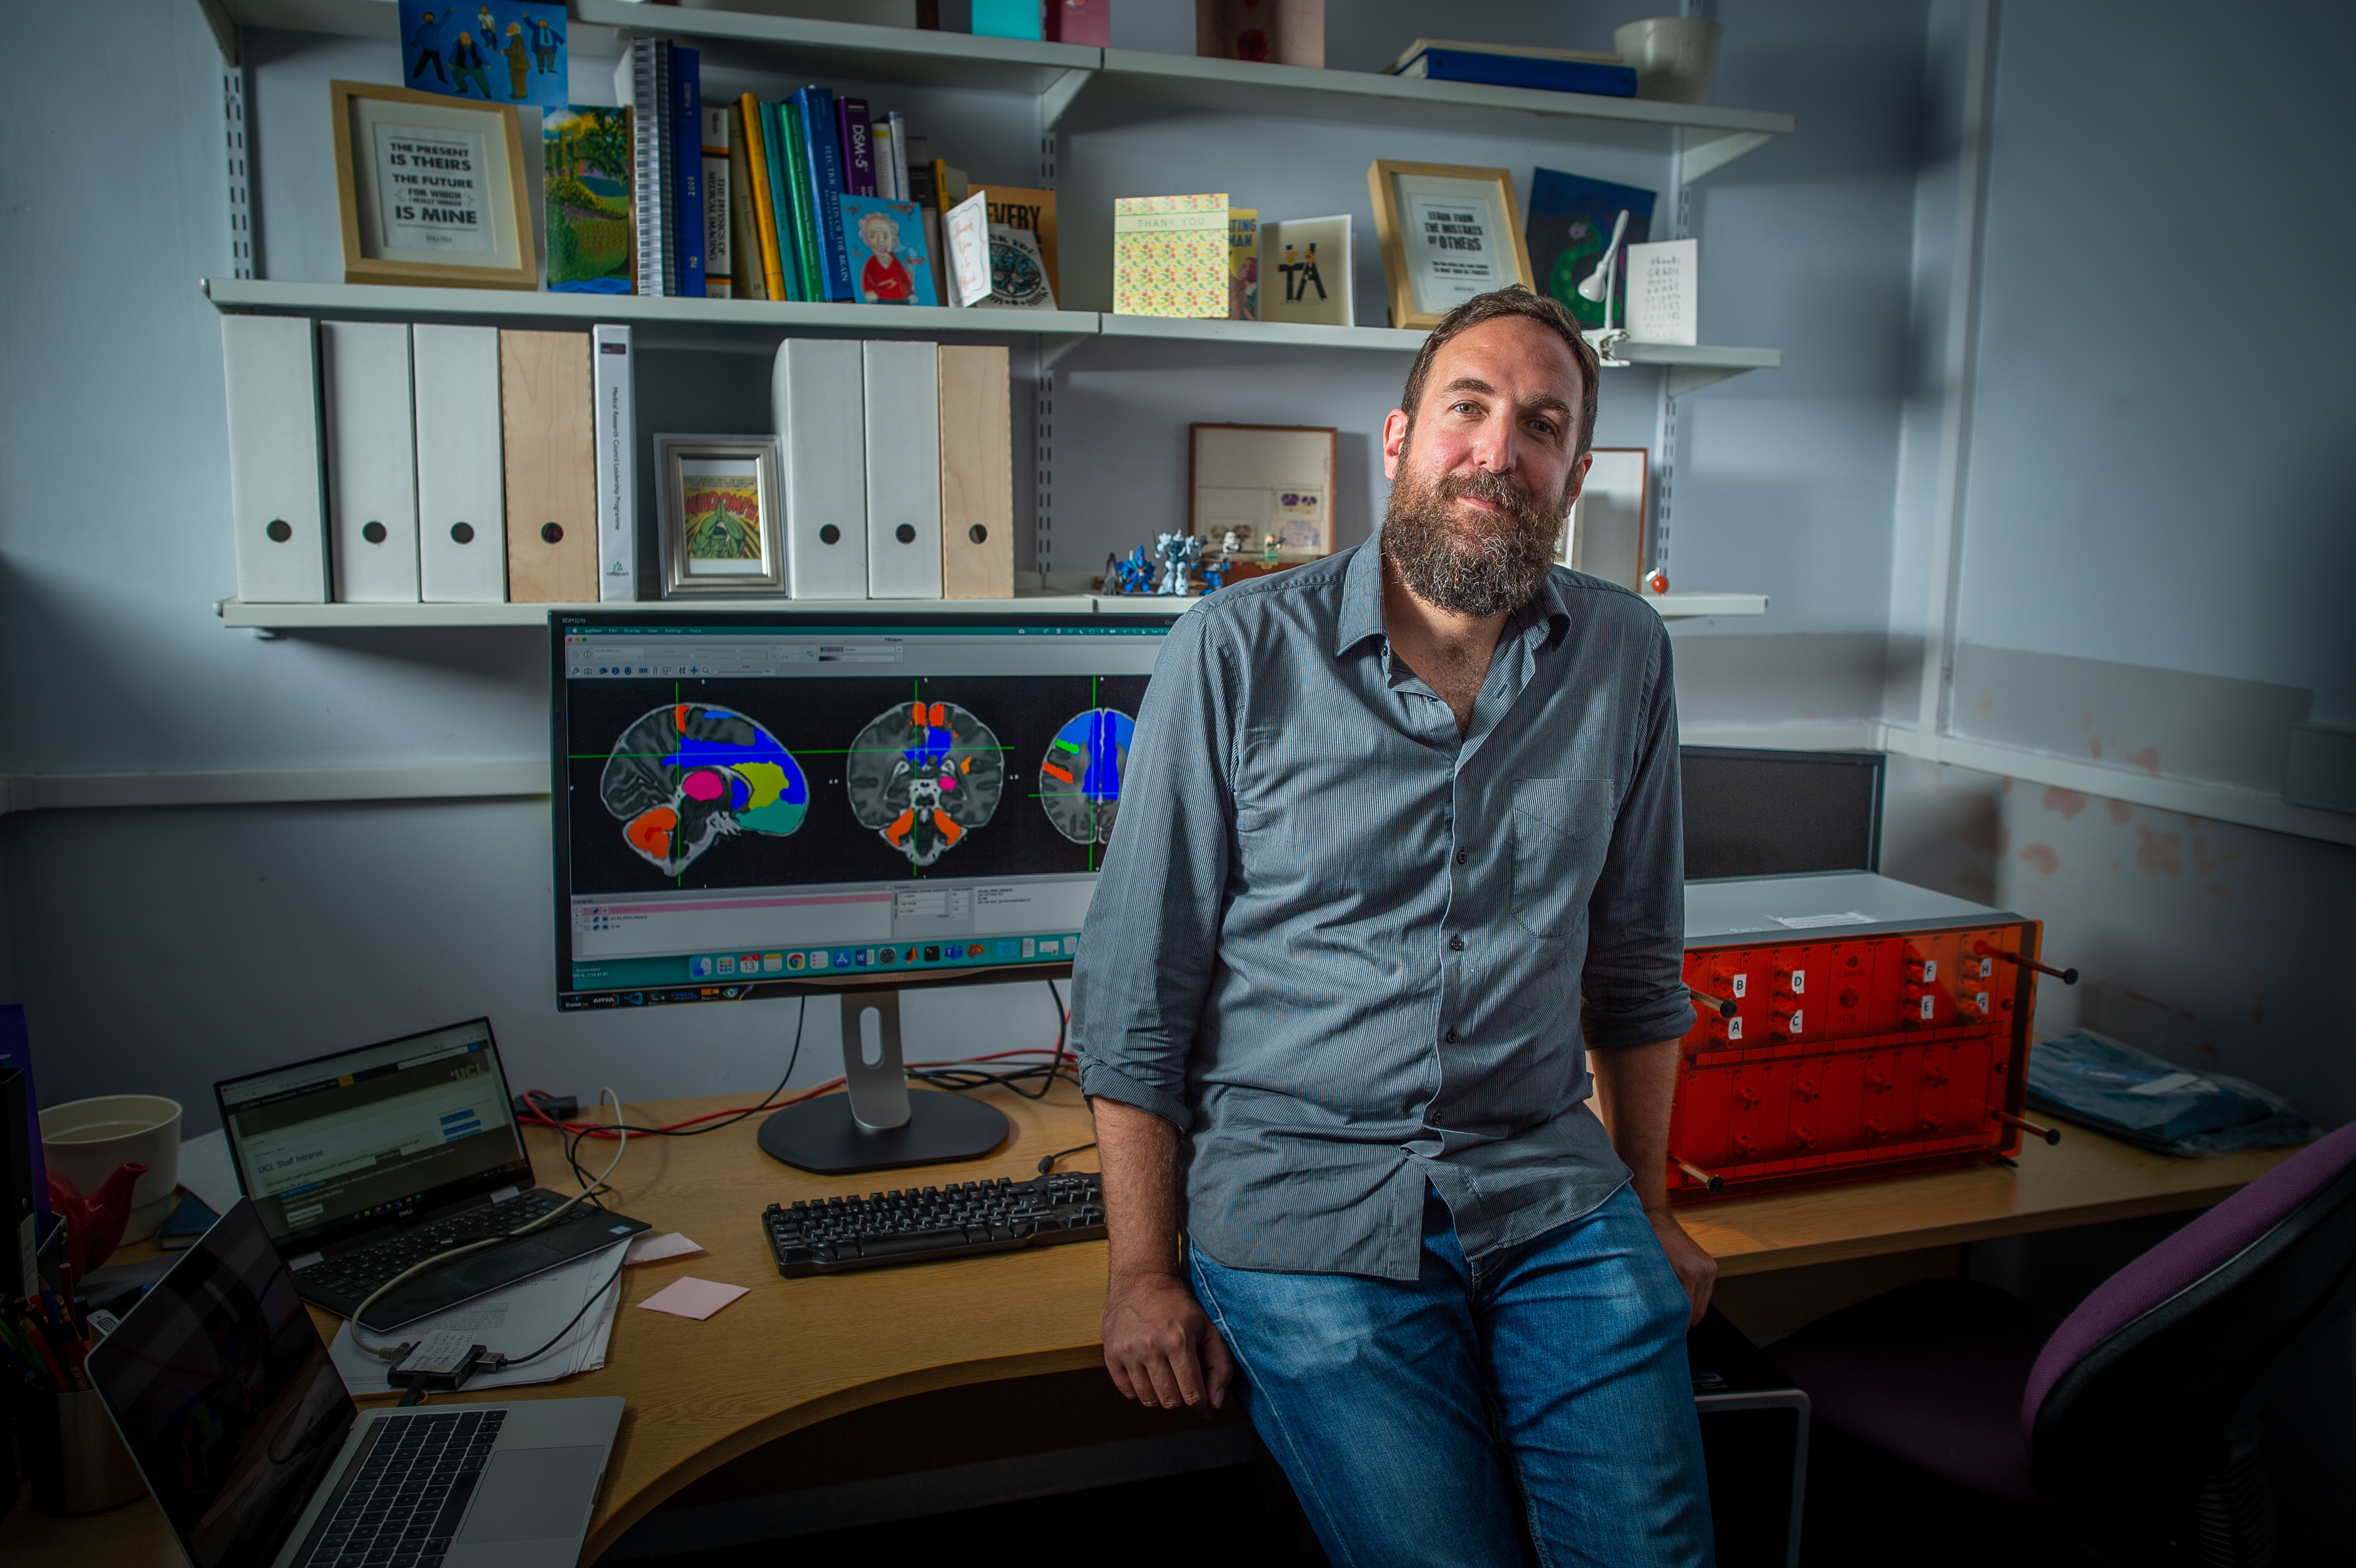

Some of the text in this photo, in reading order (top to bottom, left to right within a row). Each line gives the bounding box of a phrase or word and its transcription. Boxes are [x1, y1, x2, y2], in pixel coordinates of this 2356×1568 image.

[390, 142, 469, 158] THE PRESENT
[852, 124, 869, 169] DSM-5
[390, 153, 471, 171] IS THEIRS
[824, 145, 836, 190] ELECTRIC
[392, 173, 473, 188] THE FUTURE
[408, 188, 461, 199] FOR WHICH
[395, 206, 477, 224] IS MINE
[708, 170, 717, 261] MEDICAL IMAGING
[718, 199, 726, 240] PHYSICS
[1452, 213, 1475, 223] FROM
[952, 218, 976, 240] Thank
[1137, 218, 1205, 228] THANK YOU
[1424, 222, 1483, 236] THE MISTAKES
[718, 242, 726, 256] OF
[837, 236, 845, 250] THE
[957, 240, 972, 258] You
[1439, 235, 1483, 251] OTHERS
[839, 254, 849, 283] BRAIN
[684, 491, 759, 530] WHOOMPH!
[743, 962, 755, 971] 13
[1926, 965, 1933, 976] F
[1982, 964, 1989, 974] H
[1736, 980, 1744, 991] B
[1794, 976, 1802, 987] D
[1924, 1001, 1931, 1012] E
[1792, 1015, 1800, 1027] C
[1839, 1014, 1856, 1024] NTS
[1731, 1021, 1740, 1032] A
[455, 1063, 485, 1081] UCL
[258, 1150, 324, 1175] UCL Staff Intranet
[274, 1179, 284, 1187] help
[398, 1208, 414, 1218] DELL
[438, 1334, 450, 1346] THIS
[463, 1332, 473, 1346] THIS
[441, 1342, 452, 1353] STAY
